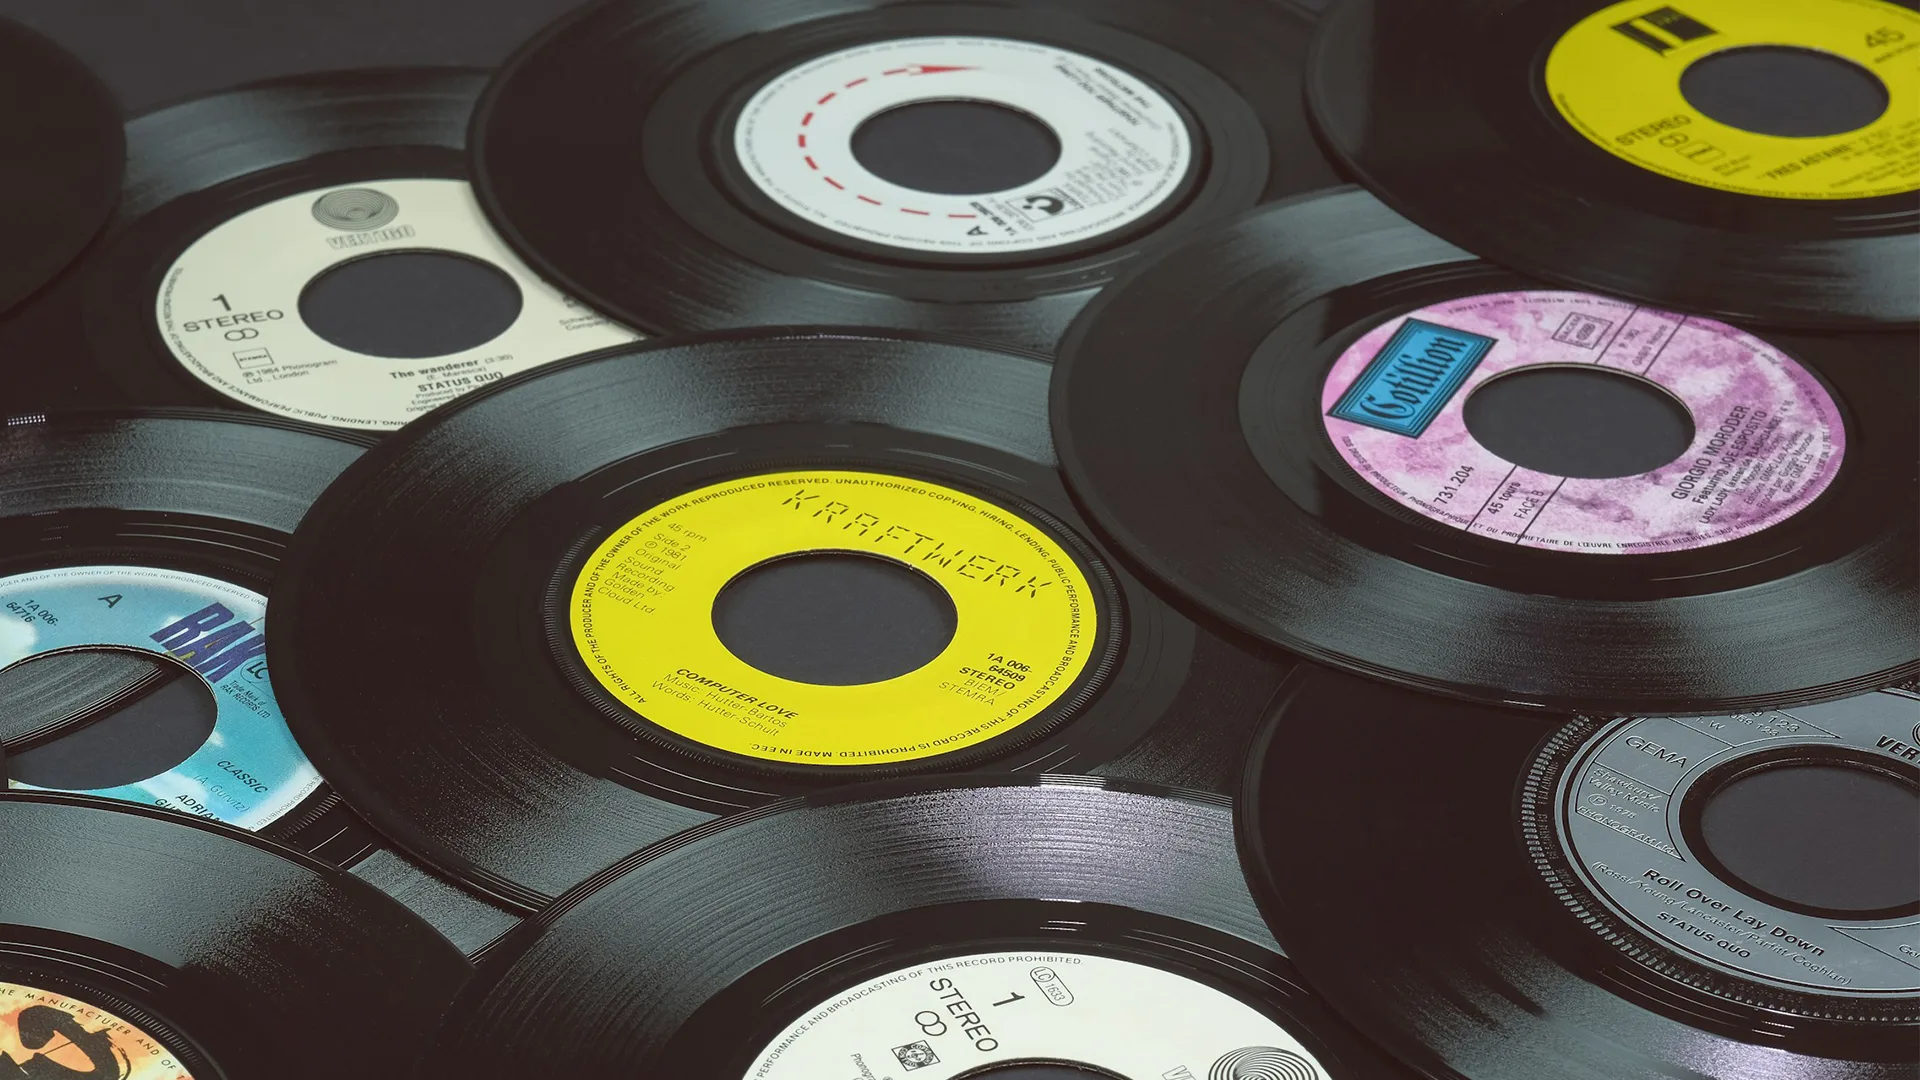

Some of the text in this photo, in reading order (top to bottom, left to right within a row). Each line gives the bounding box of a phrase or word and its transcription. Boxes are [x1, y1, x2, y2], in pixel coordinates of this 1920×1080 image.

[1615, 114, 1692, 148] STEREO
[325, 225, 416, 250] VERTIGO
[960, 224, 991, 239] A
[212, 294, 232, 311] 1
[183, 309, 284, 332] STEREO
[273, 370, 308, 380] London
[282, 359, 338, 371] Phonogram
[389, 360, 479, 379] The wanderer
[417, 372, 504, 392] STATUS QUO
[1358, 336, 1468, 419] Cotillion
[226, 384, 377, 424] LENDING, PUBLIC PERFORMANCE
[416, 388, 454, 398] Produced
[1339, 435, 1356, 447] TOUS
[1727, 409, 1770, 450] ESPOSITO
[1347, 447, 1369, 463] DROITS
[1668, 457, 1715, 500] GIORGIO
[1700, 404, 1754, 456] MORODER
[1790, 433, 1817, 457] Moroder
[1716, 451, 1740, 468] JOE
[1776, 456, 1802, 477] Giorgio
[1368, 470, 1410, 496] PRODUCTEUR
[1433, 465, 1475, 504] 731.204
[1690, 467, 1731, 505] Featuring
[1697, 504, 1720, 524] LADY
[1710, 487, 1732, 506] LADY
[1739, 457, 1754, 466] de
[1771, 477, 1788, 488] par
[1779, 478, 1799, 493] pour
[1406, 495, 1471, 524] PHONOGRAPHIQUE
[1487, 482, 1521, 514] 45 tours
[1514, 496, 1538, 519] FACE
[1754, 487, 1779, 508] Produit
[654, 533, 680, 548] Side
[668, 523, 707, 543] 45 rpm
[1484, 525, 1499, 533] DU
[661, 547, 687, 561] 1981
[781, 489, 1052, 598] KRAFTWERK
[624, 556, 664, 576] Sound
[636, 548, 681, 571] Original
[20, 574, 41, 583] AND
[158, 572, 214, 588] REPRODUCED
[604, 578, 645, 599] Golden
[612, 572, 665, 598] Made by:
[616, 562, 675, 592] Recording
[6, 602, 36, 623] 64716
[24, 600, 59, 627] 1A 006-
[97, 594, 123, 609] A
[598, 587, 656, 616] Cloud Ltd.
[581, 477, 1082, 757] ALL RIGHTS OF THE PRODUCER AND OF THE OWNER OF THE WORK REPRODUCED RESERVED. UNAUTHORIZED COPYING, HIRING, LENDING, PUBLIC PERFORMANCE AND BROADCASTING OF THIS RECORD IS PROHIBITED. MADE IN EEC.
[149, 602, 265, 684] RAK
[246, 661, 268, 679] LC
[987, 653, 1032, 673] 1A 006-
[988, 665, 1026, 682] 64509
[229, 680, 258, 701] Trade Mark
[959, 667, 1015, 690] STEREO
[964, 679, 1007, 697] BIEM/
[220, 685, 259, 712] RAK RECORDS
[663, 674, 787, 728] Music: Hutter-Bartos
[676, 668, 799, 719] COMPUTER LOVE
[939, 681, 995, 706] STEMRA
[652, 680, 779, 737] Words: Hutter-Schult
[1768, 715, 1800, 732] 123
[1625, 734, 1689, 768] GEMA
[217, 760, 268, 793] CLASSIC
[1594, 768, 1664, 802] Shawbury/
[210, 785, 250, 812] Gurvitz)
[291, 779, 319, 800] RECORD
[1588, 776, 1661, 814] Valley Music
[1577, 805, 1657, 847] PHONOGRAM
[1642, 868, 1825, 957] Roll Over Lay Down
[1657, 911, 1751, 959] STATUS QUO
[1032, 967, 1067, 1002] LC 1633
[992, 992, 1025, 1007] 1
[754, 955, 1084, 1078] PERFORMANCE AND BROADCASTING OF THIS RECORD PROHIBITED.
[929, 978, 999, 1052] STEREO
[25, 992, 177, 1070] MANUFACTURER AND OF
